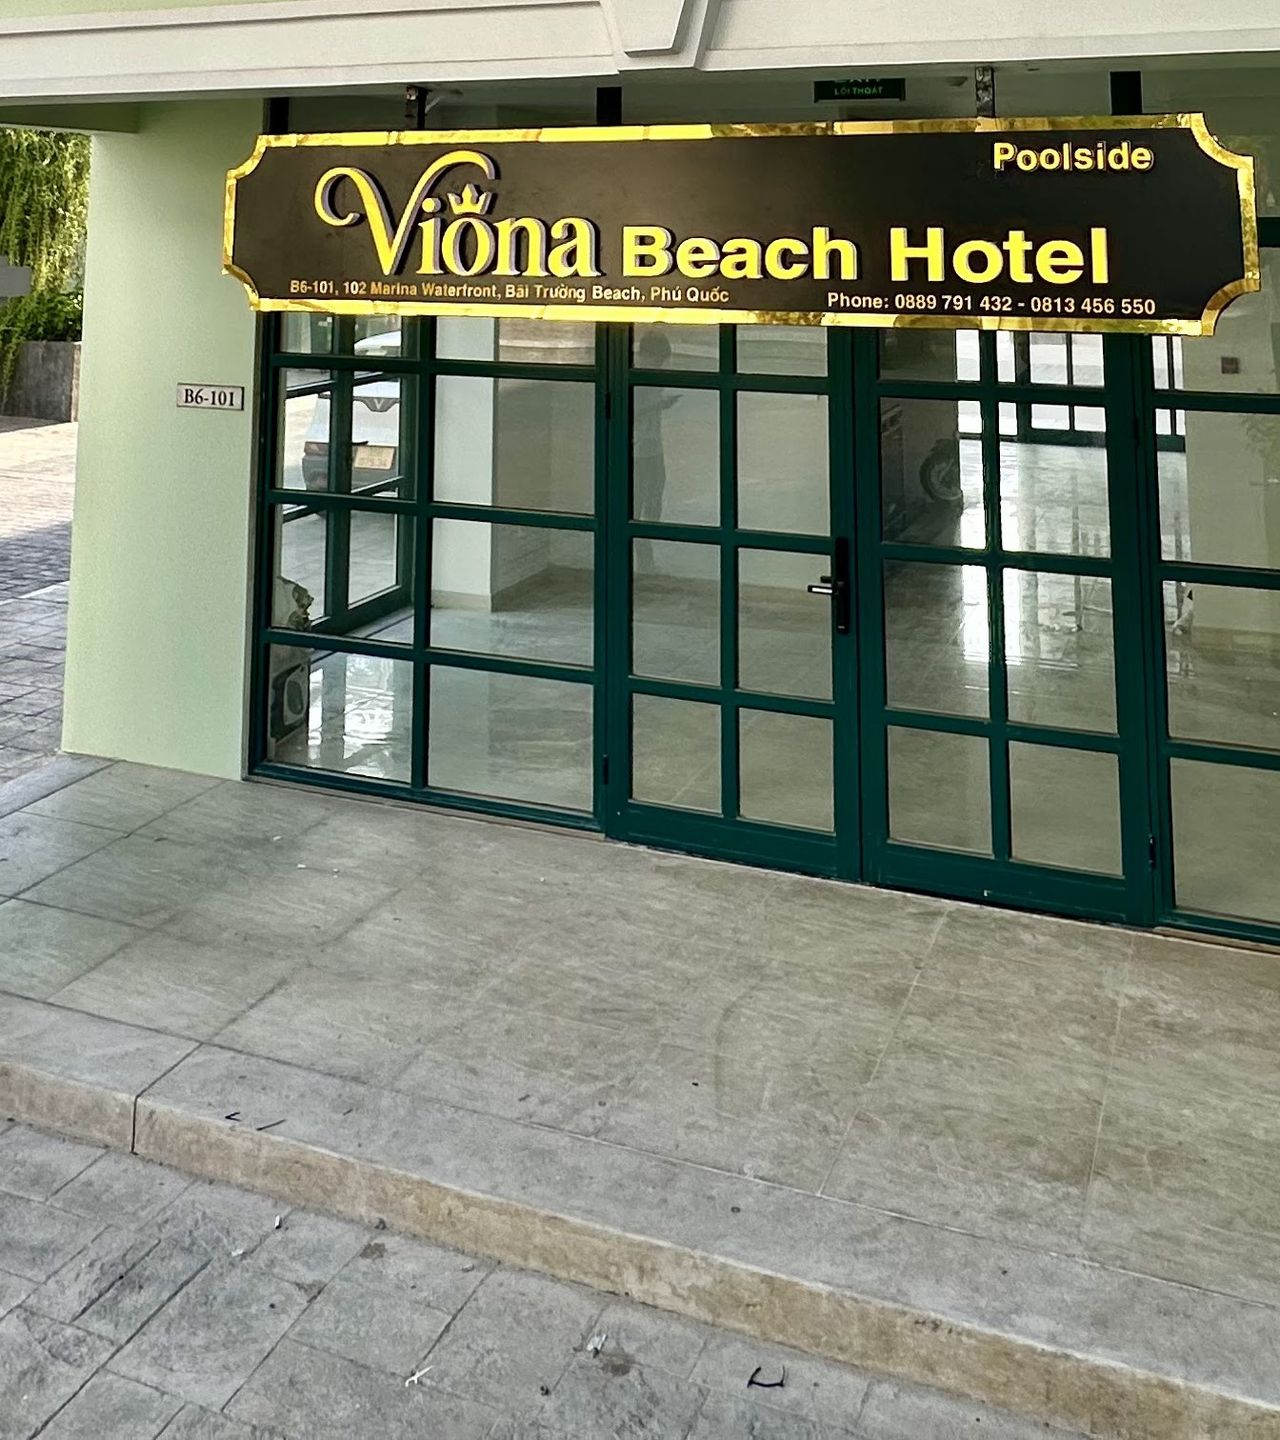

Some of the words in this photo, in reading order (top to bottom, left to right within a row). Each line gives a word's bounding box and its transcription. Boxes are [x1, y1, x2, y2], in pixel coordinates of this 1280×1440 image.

[993, 141, 1154, 171] Poolside
[314, 150, 606, 276] Viona
[622, 226, 858, 280] Beach
[889, 227, 1110, 284] Hotel
[290, 280, 339, 295] B6-101,
[343, 281, 367, 295] 102
[370, 281, 417, 296] Marina
[422, 282, 502, 300] Waterfront,
[534, 283, 586, 302] Trường
[592, 285, 646, 301] Beach,
[650, 286, 681, 301] Phú
[686, 286, 729, 302] Quốc
[827, 292, 889, 308] Phone:
[894, 294, 937, 309] 0889
[941, 295, 972, 310] 791
[979, 296, 1012, 311] 432
[1030, 297, 1075, 313] 0813
[1081, 298, 1115, 314] 456
[1121, 299, 1156, 315] 550
[184, 388, 234, 407] B6-101
